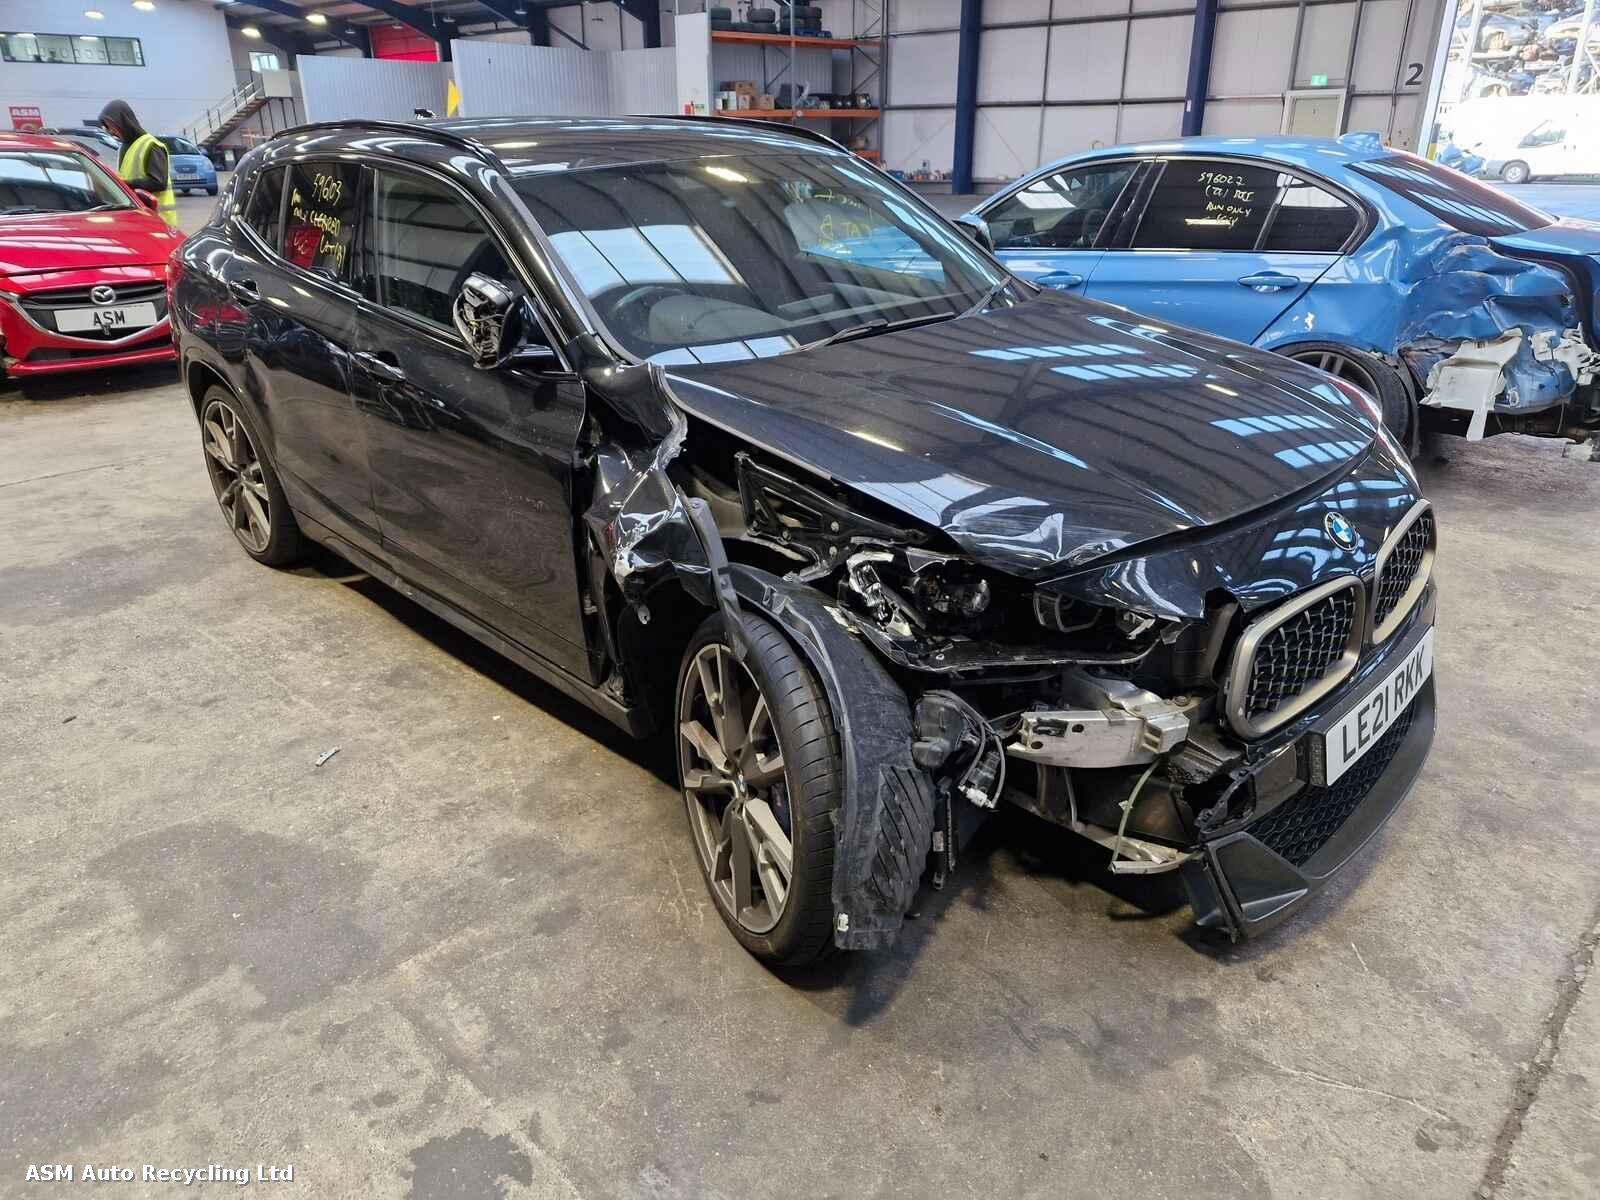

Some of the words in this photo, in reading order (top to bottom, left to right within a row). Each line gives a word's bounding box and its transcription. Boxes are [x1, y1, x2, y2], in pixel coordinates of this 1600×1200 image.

[1405, 62, 1424, 86] 2
[12, 108, 40, 117] ASM
[92, 310, 126, 327] ASM
[1342, 685, 1389, 763] LE21
[1393, 644, 1425, 712] RKK
